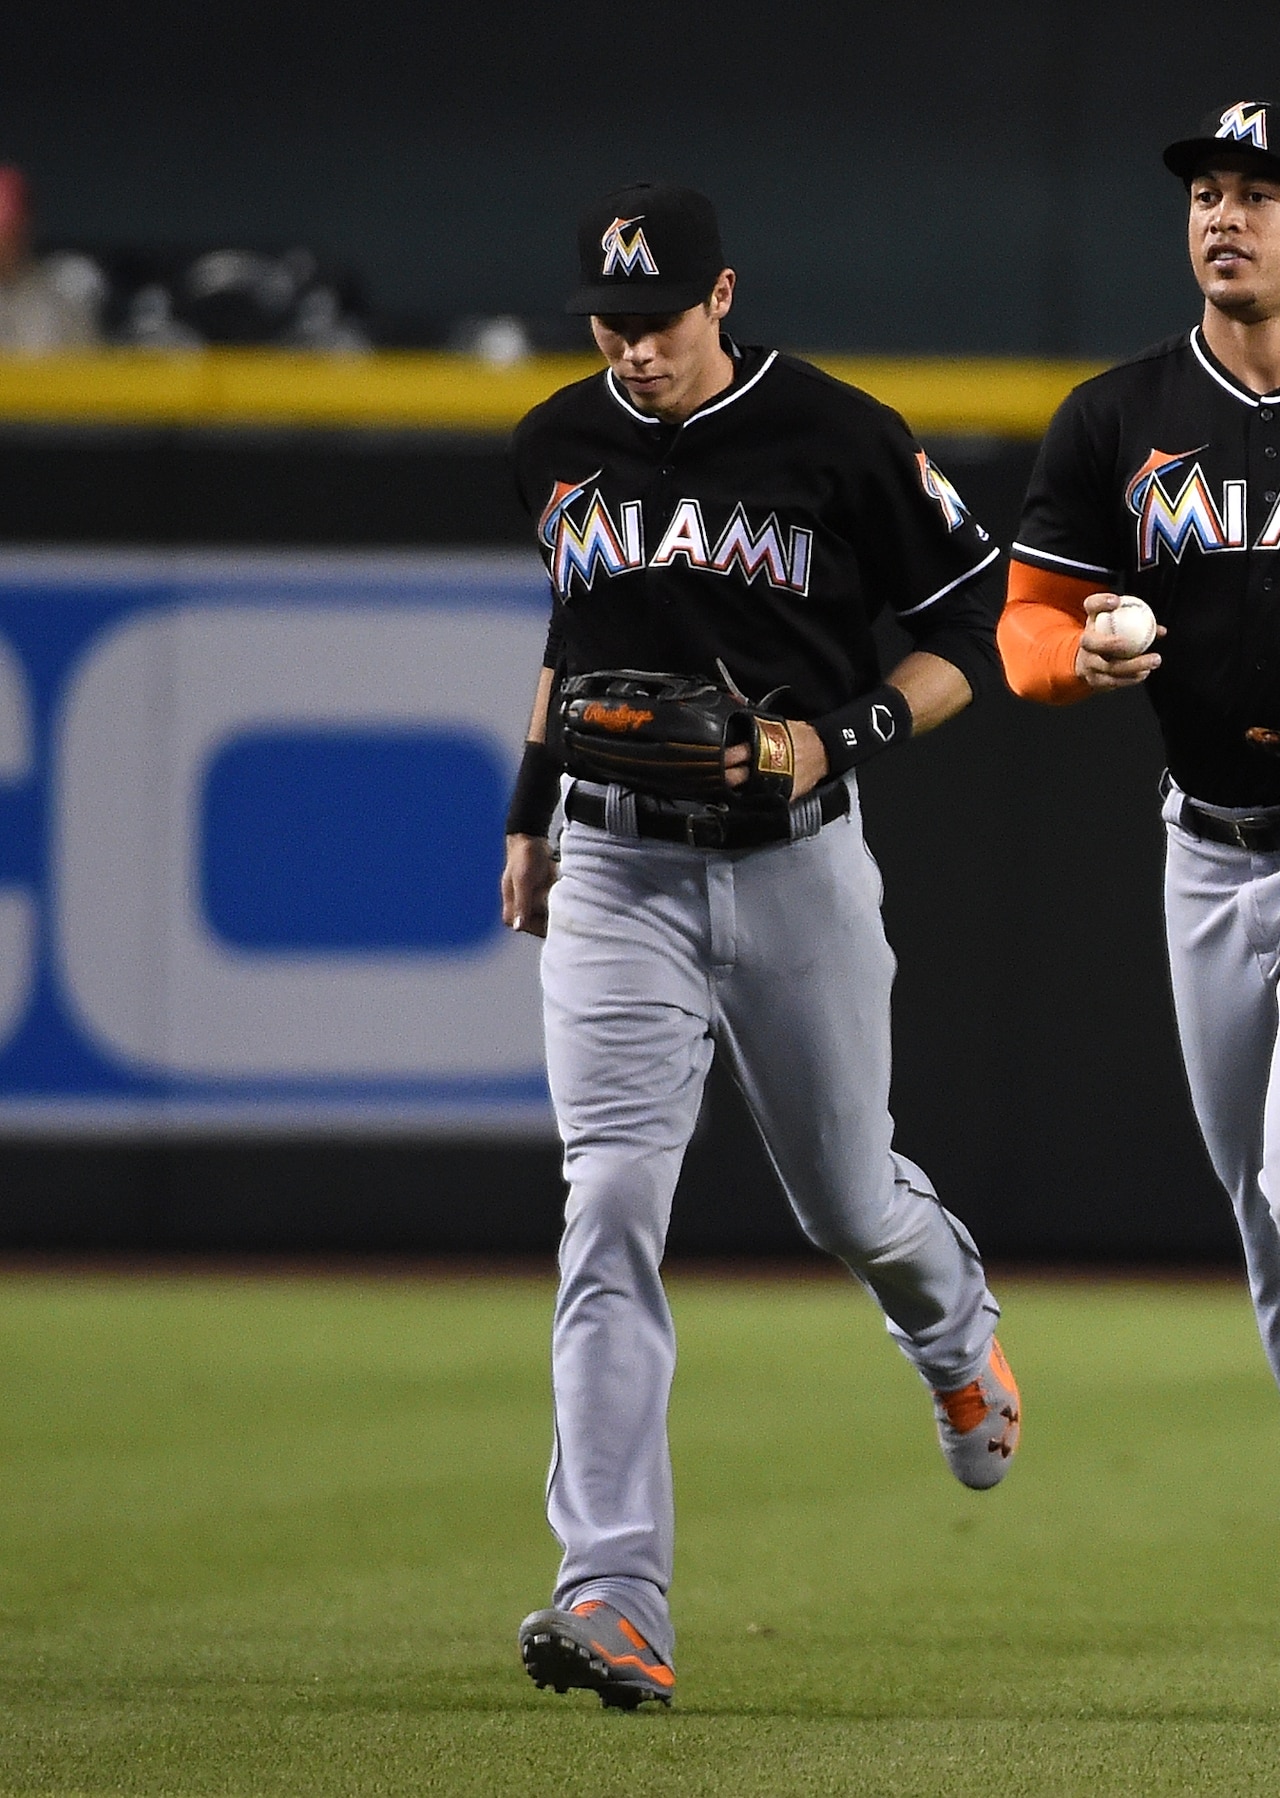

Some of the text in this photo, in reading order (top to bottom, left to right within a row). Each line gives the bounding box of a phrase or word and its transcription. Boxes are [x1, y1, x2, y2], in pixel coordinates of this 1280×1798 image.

[602, 216, 660, 276] M
[541, 488, 813, 605] MIAMI
[841, 727, 858, 746] 21
